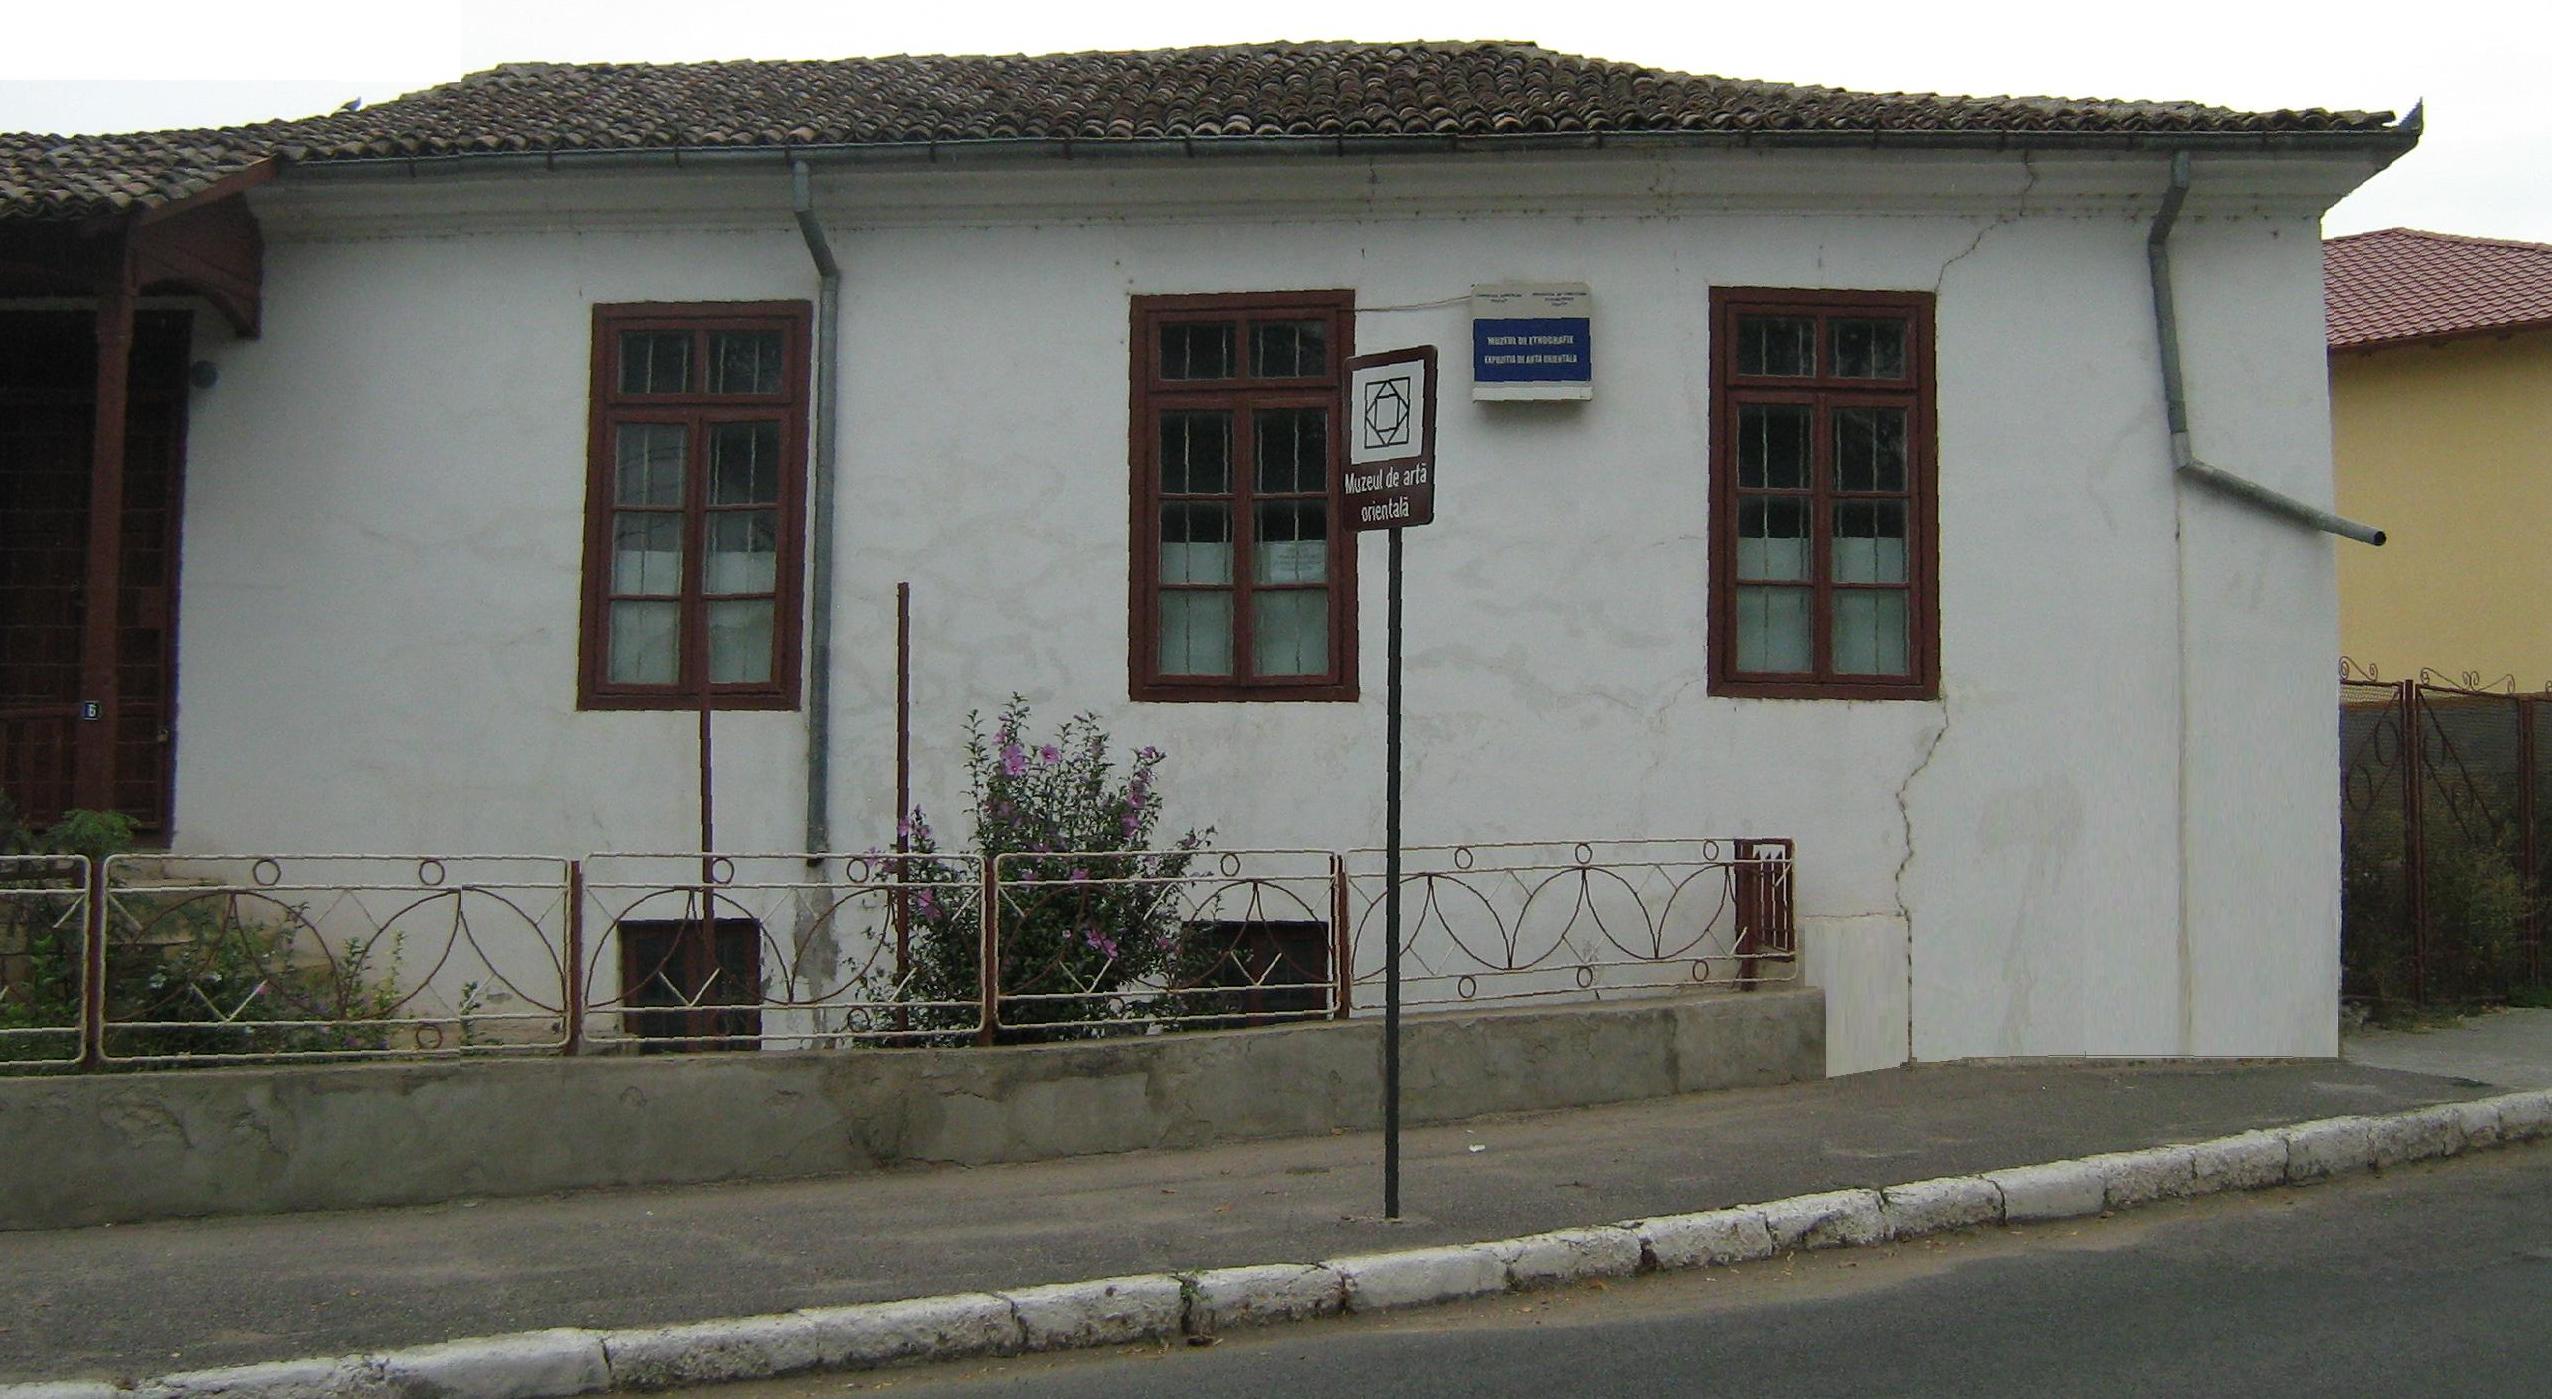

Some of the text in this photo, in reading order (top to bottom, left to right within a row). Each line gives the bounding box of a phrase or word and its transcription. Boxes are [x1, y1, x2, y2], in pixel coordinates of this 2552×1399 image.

[1487, 335, 1574, 346] MUZEUL DE ETNOGRAFIE
[1517, 354, 1525, 364] DE
[1344, 462, 1427, 494] Muzeul de artă
[1361, 496, 1410, 522] orientală
[89, 704, 97, 717] 6
